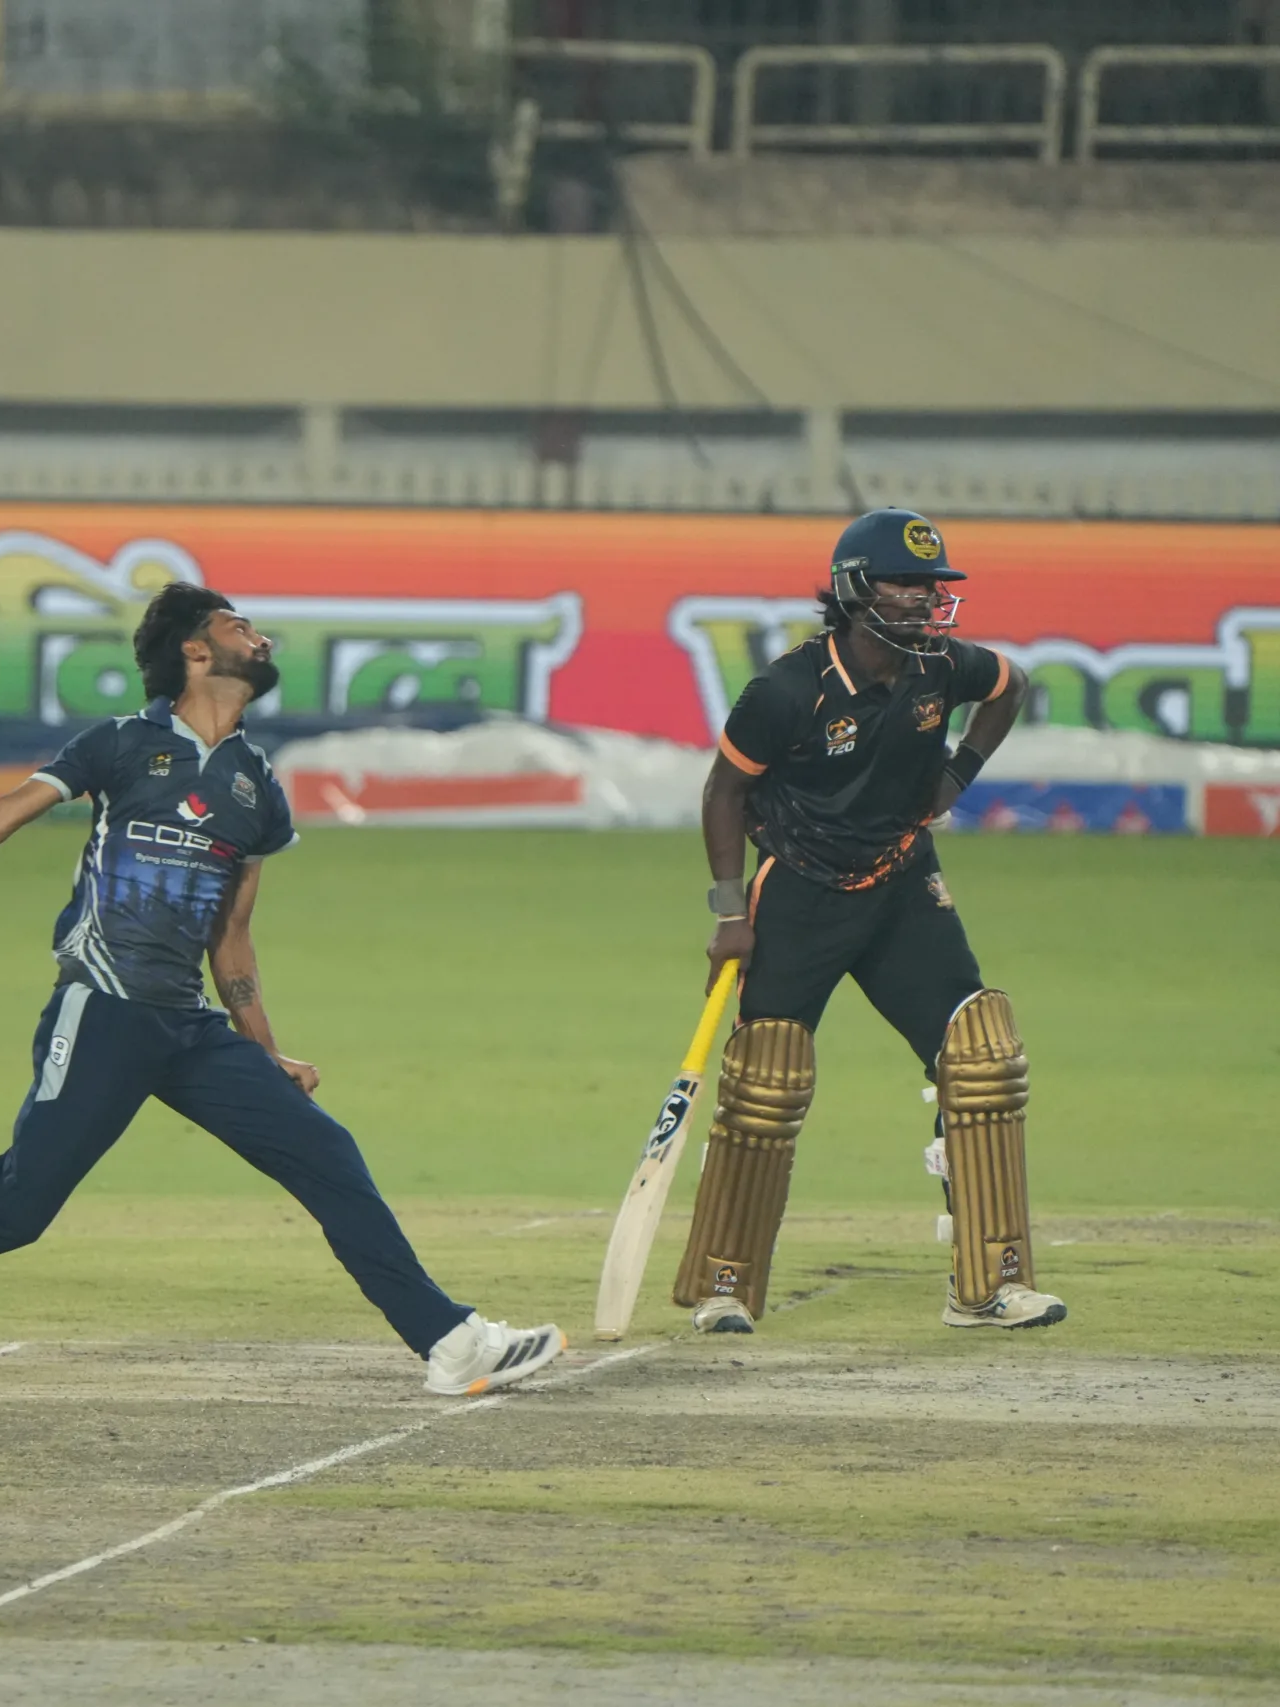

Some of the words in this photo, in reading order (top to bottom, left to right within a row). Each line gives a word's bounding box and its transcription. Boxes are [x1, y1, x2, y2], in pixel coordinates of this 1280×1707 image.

[668, 596, 1280, 748] Val
[827, 740, 856, 757] T20
[135, 852, 161, 865] flying
[161, 857, 189, 868] colors
[1001, 1267, 1018, 1277] T20
[714, 1284, 735, 1294] T20
